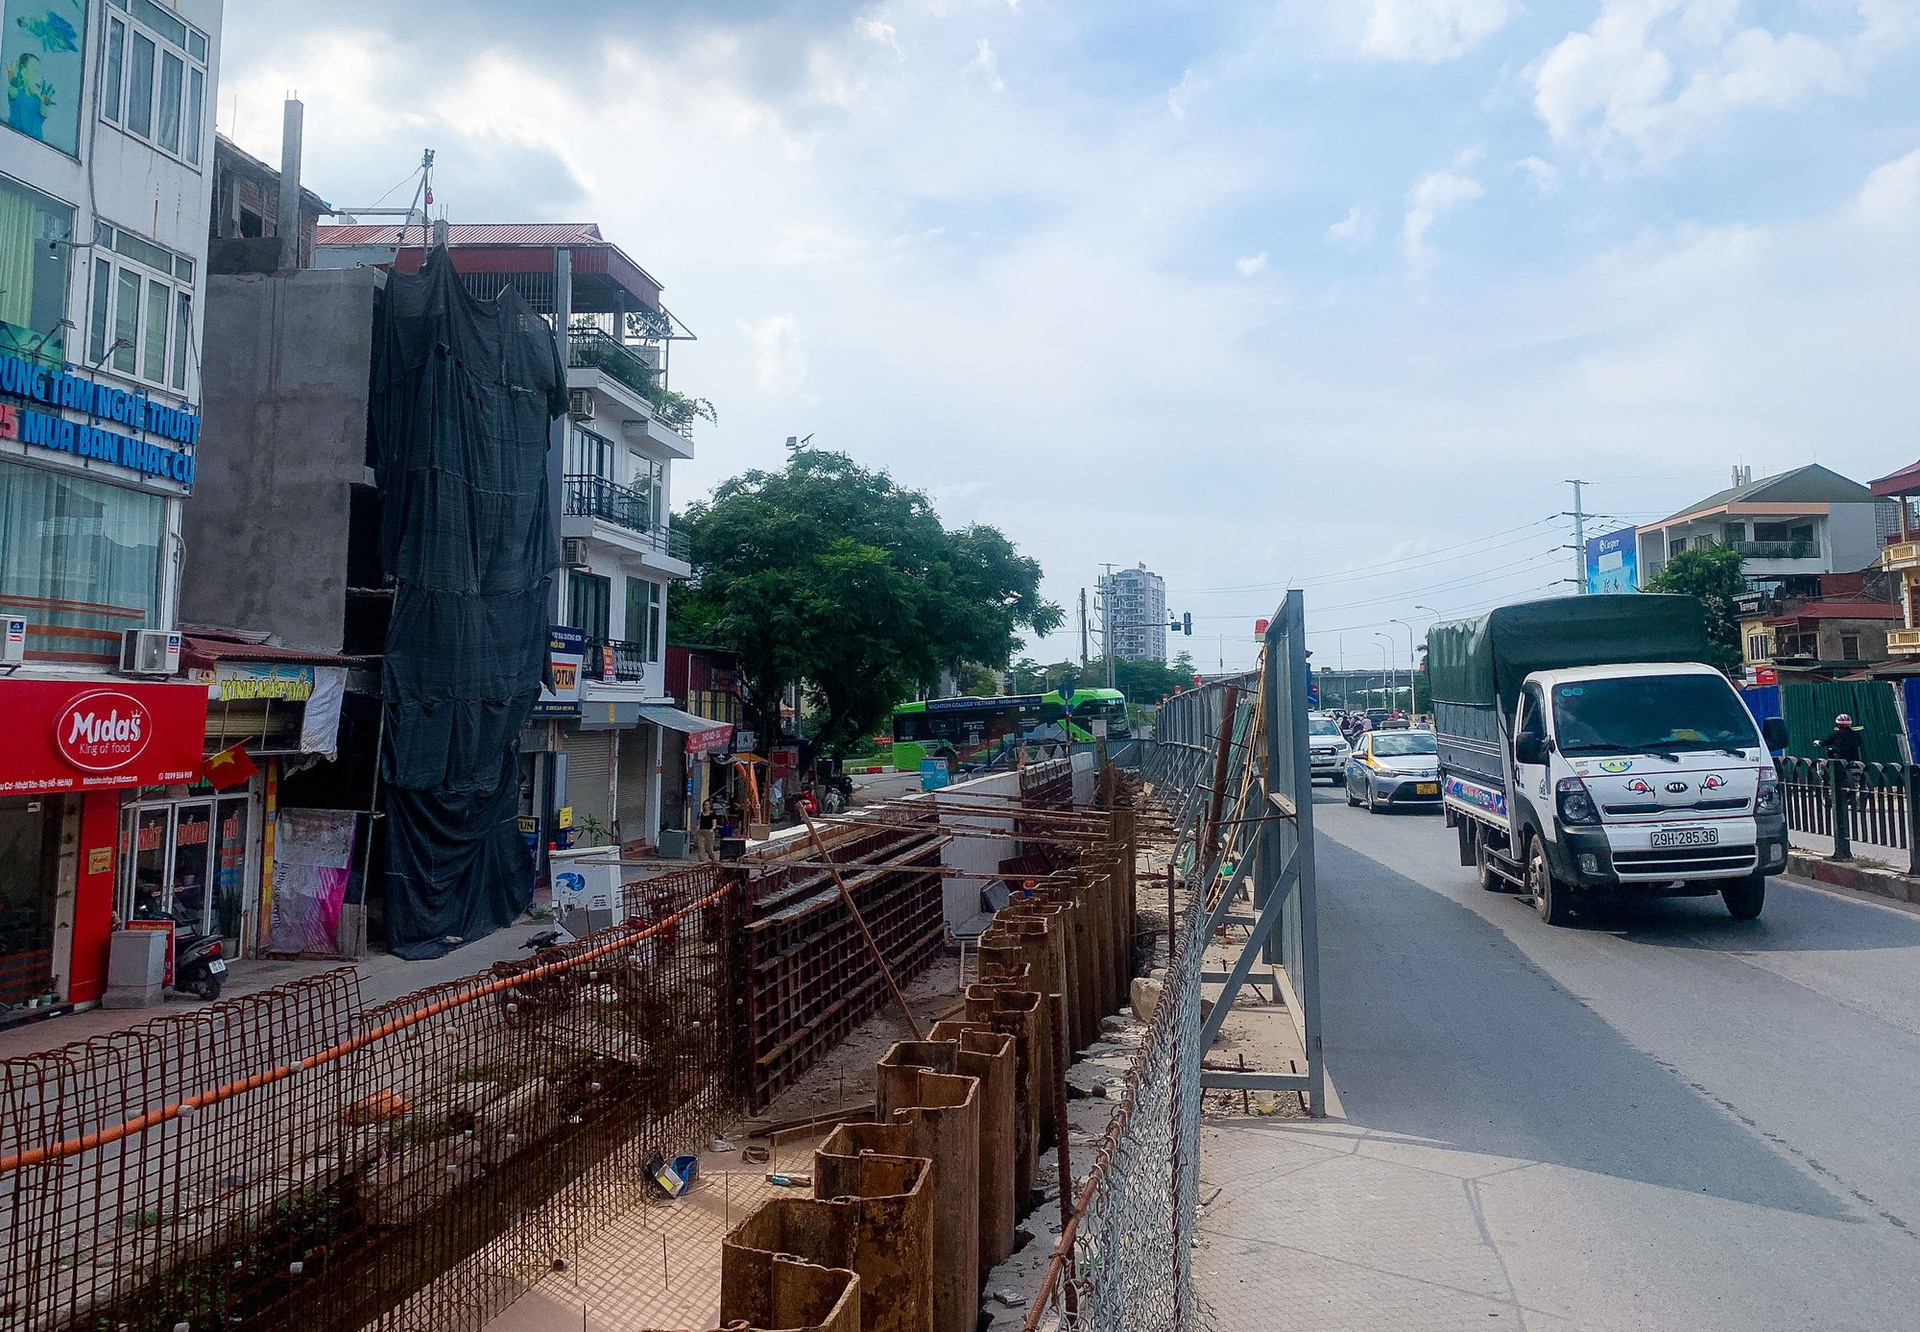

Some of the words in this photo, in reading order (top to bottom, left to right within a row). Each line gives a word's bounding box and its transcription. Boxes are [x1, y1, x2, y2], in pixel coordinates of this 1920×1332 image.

[0, 354, 46, 401] UNG
[24, 410, 75, 452] MUA
[68, 709, 141, 744] Midas
[79, 743, 98, 756] King
[100, 742, 110, 754] of
[112, 742, 131, 753] food
[1668, 783, 1686, 792] KIA
[1653, 830, 1717, 847] 29H-285.36
